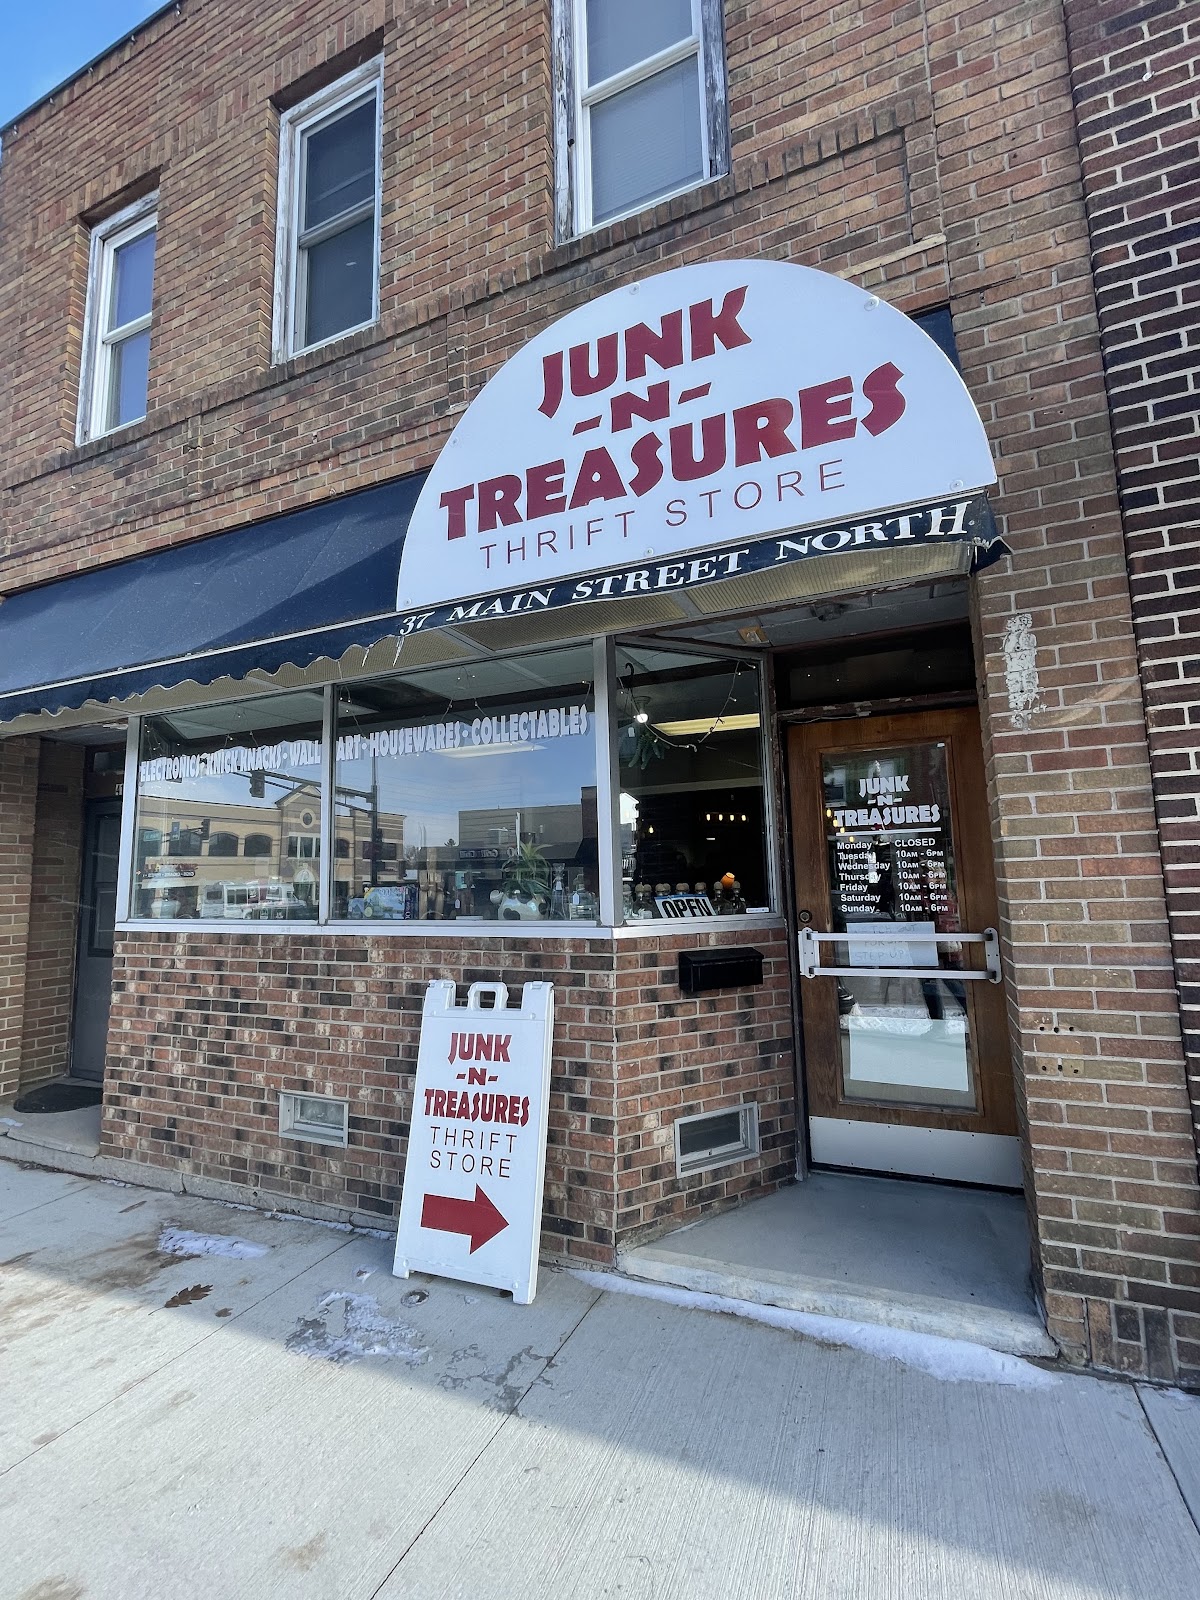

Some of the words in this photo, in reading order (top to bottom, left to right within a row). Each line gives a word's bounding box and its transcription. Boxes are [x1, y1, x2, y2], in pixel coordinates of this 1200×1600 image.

[537, 284, 753, 419] JUNK
[572, 380, 712, 436] -N-
[439, 361, 906, 541] TREASURES
[480, 510, 635, 569] THRIFT
[665, 458, 846, 528] STORE
[399, 612, 435, 636] 37
[447, 588, 553, 624] MAIN
[572, 550, 752, 600] STREET
[774, 501, 974, 561] NORTH
[140, 754, 200, 782] ELECTRONICS
[290, 740, 321, 766] WALL
[336, 734, 361, 761] ART
[369, 721, 460, 758] HOUSEWARES
[471, 704, 588, 746] COLLECTABLES
[859, 775, 910, 798] JUNK
[867, 795, 902, 806] -N-
[834, 804, 941, 827] TREASURES
[837, 841, 872, 850] Monday
[894, 838, 936, 847] CLOSED
[896, 850, 918, 858] 10AM
[926, 849, 944, 857] 6PM
[838, 861, 890, 871] Wednesday
[896, 860, 919, 869] 10AM
[927, 860, 945, 868] 6PM
[897, 871, 920, 880] 10AM
[927, 870, 946, 879] 6PM
[840, 883, 868, 893] Friday
[898, 882, 921, 890] 10AM
[928, 881, 947, 890] 6PM
[840, 893, 881, 903] Saturday
[899, 893, 921, 901] 10AM
[929, 892, 948, 901] 6PM
[661, 898, 712, 918] OPEN
[841, 904, 875, 914] Sunday
[899, 904, 922, 912] 10AM
[930, 903, 948, 912] 6PM
[447, 1032, 512, 1066] JUNK
[456, 1067, 499, 1086] -N-
[424, 1088, 530, 1127] TREASURES
[430, 1126, 518, 1154] THRIFT
[429, 1150, 511, 1179] STORE
